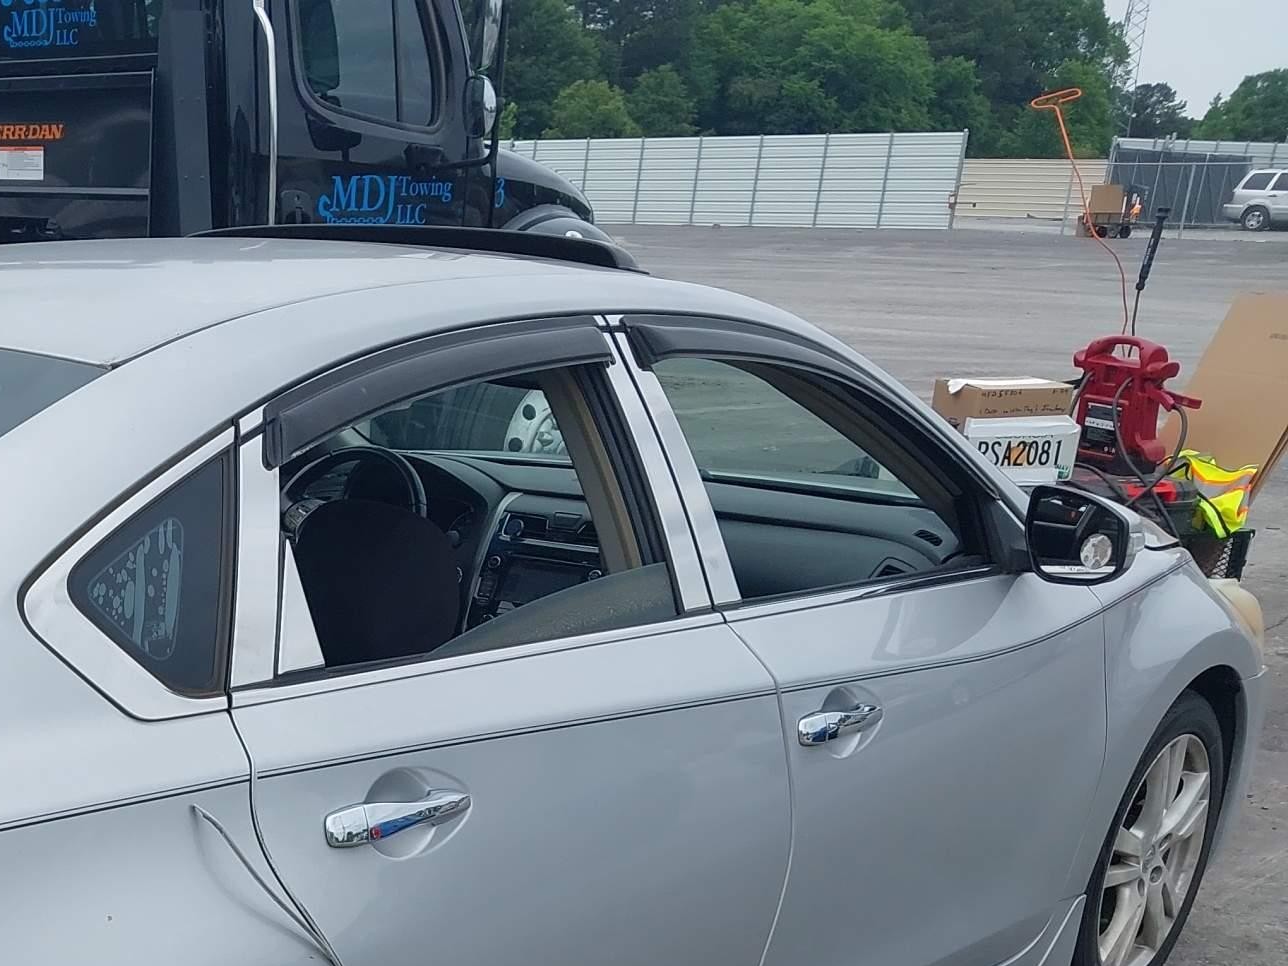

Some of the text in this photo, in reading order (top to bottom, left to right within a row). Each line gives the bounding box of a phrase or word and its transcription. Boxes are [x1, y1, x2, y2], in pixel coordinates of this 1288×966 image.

[11, 6, 97, 45] MDJ Towing
[56, 28, 78, 46] LLC
[330, 174, 454, 224] MDJ Towing
[395, 203, 427, 225] LLC
